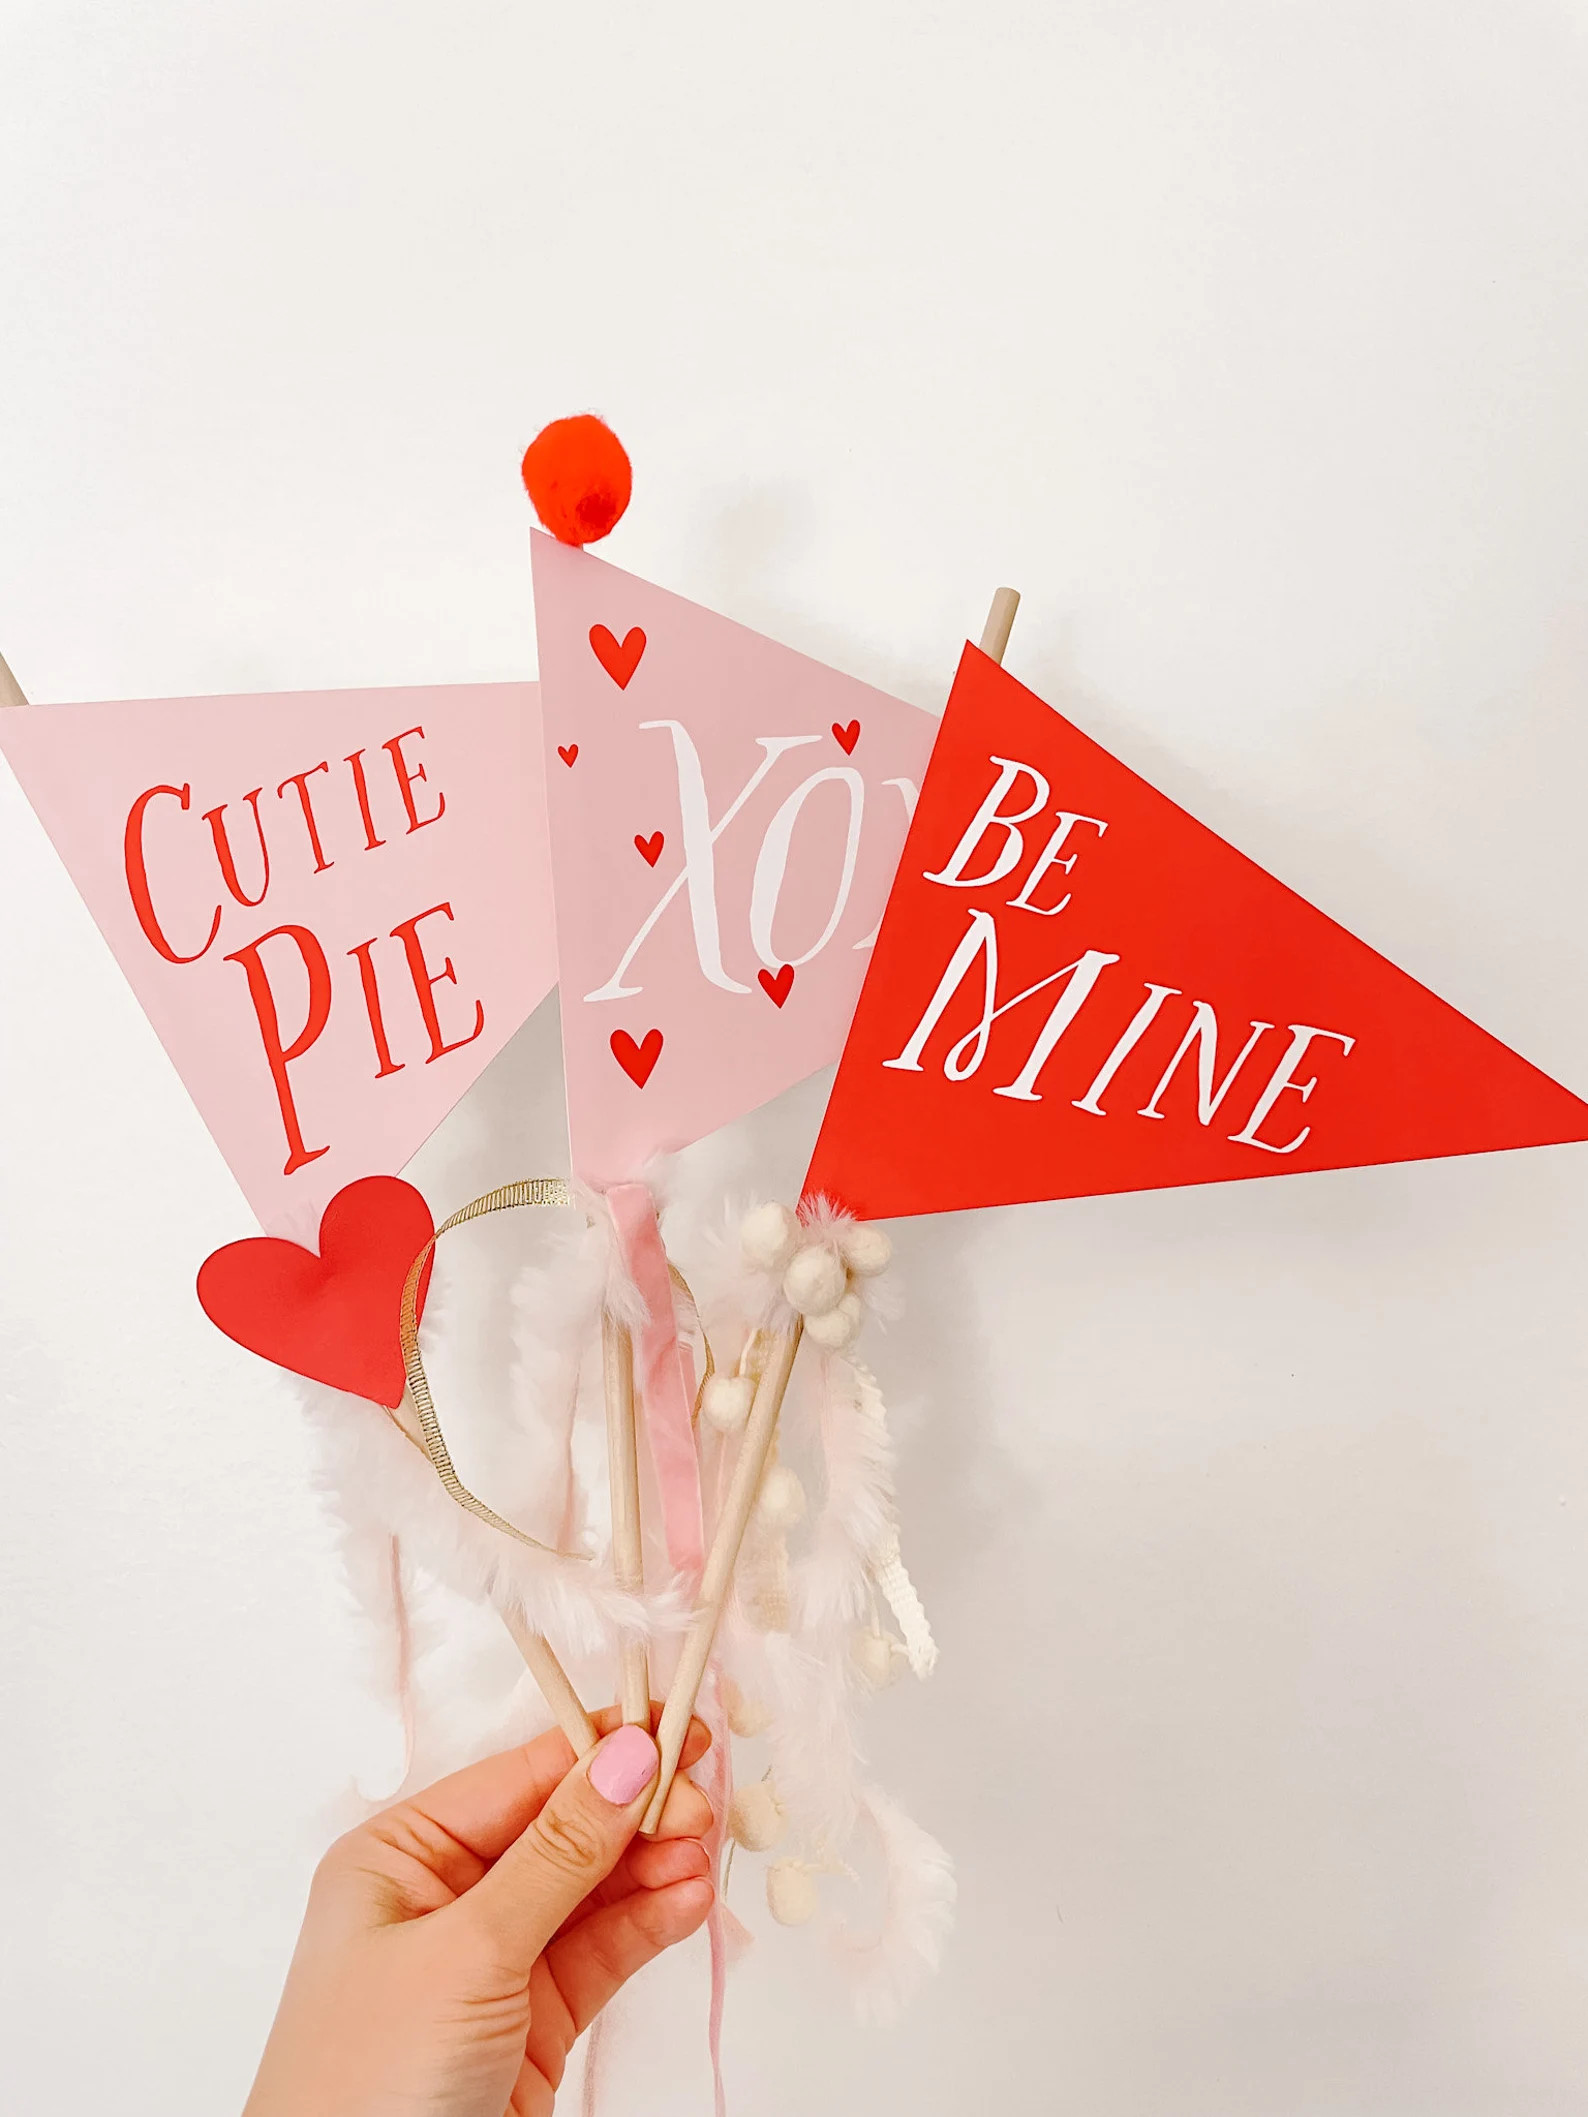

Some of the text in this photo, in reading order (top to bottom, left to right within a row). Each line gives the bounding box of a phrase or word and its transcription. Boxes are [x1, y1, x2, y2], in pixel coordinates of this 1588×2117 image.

[124, 726, 446, 964] CUTIE
[583, 719, 922, 1002] XO
[923, 755, 1109, 916] BE
[223, 902, 485, 1176] PIE
[882, 908, 1356, 1154] MINE
